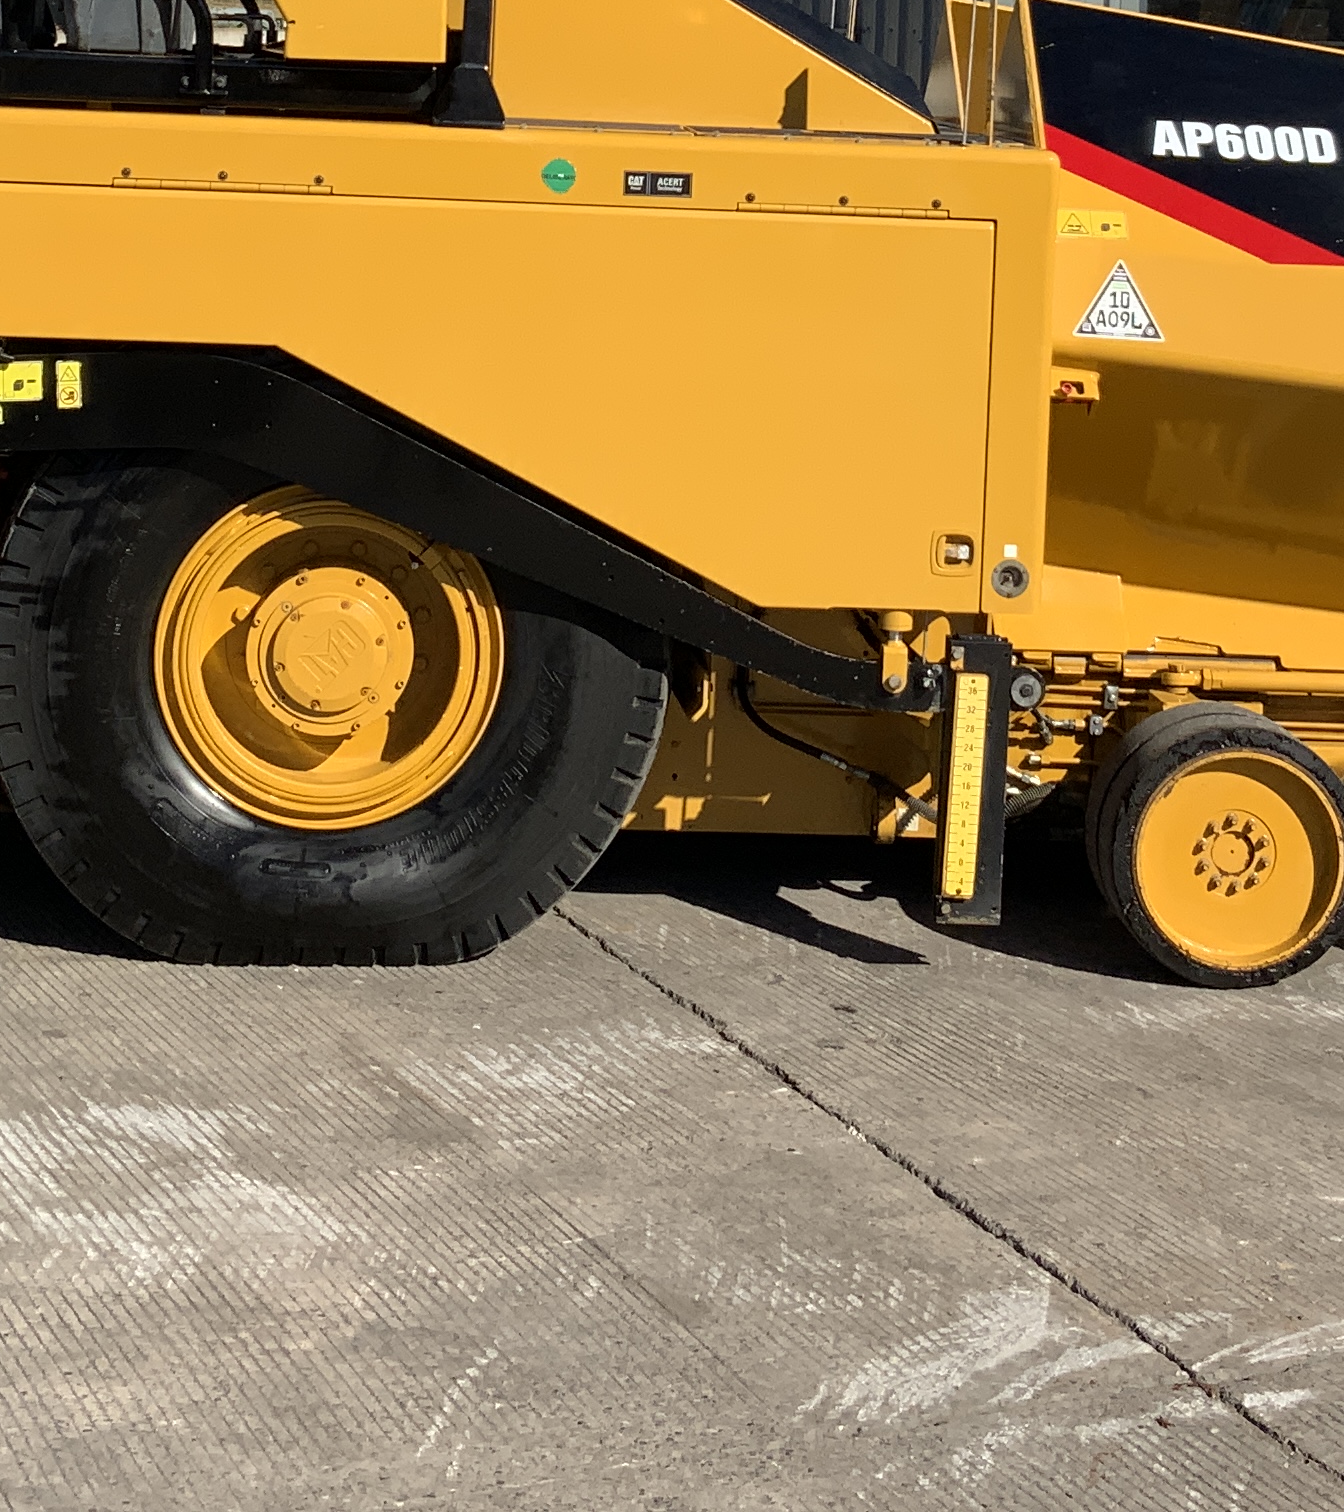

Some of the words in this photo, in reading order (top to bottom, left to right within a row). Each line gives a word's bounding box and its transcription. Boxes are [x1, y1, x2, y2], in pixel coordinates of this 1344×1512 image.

[1152, 120, 1338, 163] AP600D
[628, 175, 645, 186] CAT
[657, 177, 683, 187] ACERT
[297, 619, 366, 685] CAT
[966, 706, 976, 714] 32
[964, 744, 974, 752] 24
[962, 763, 972, 771] 20
[960, 801, 970, 809] 12
